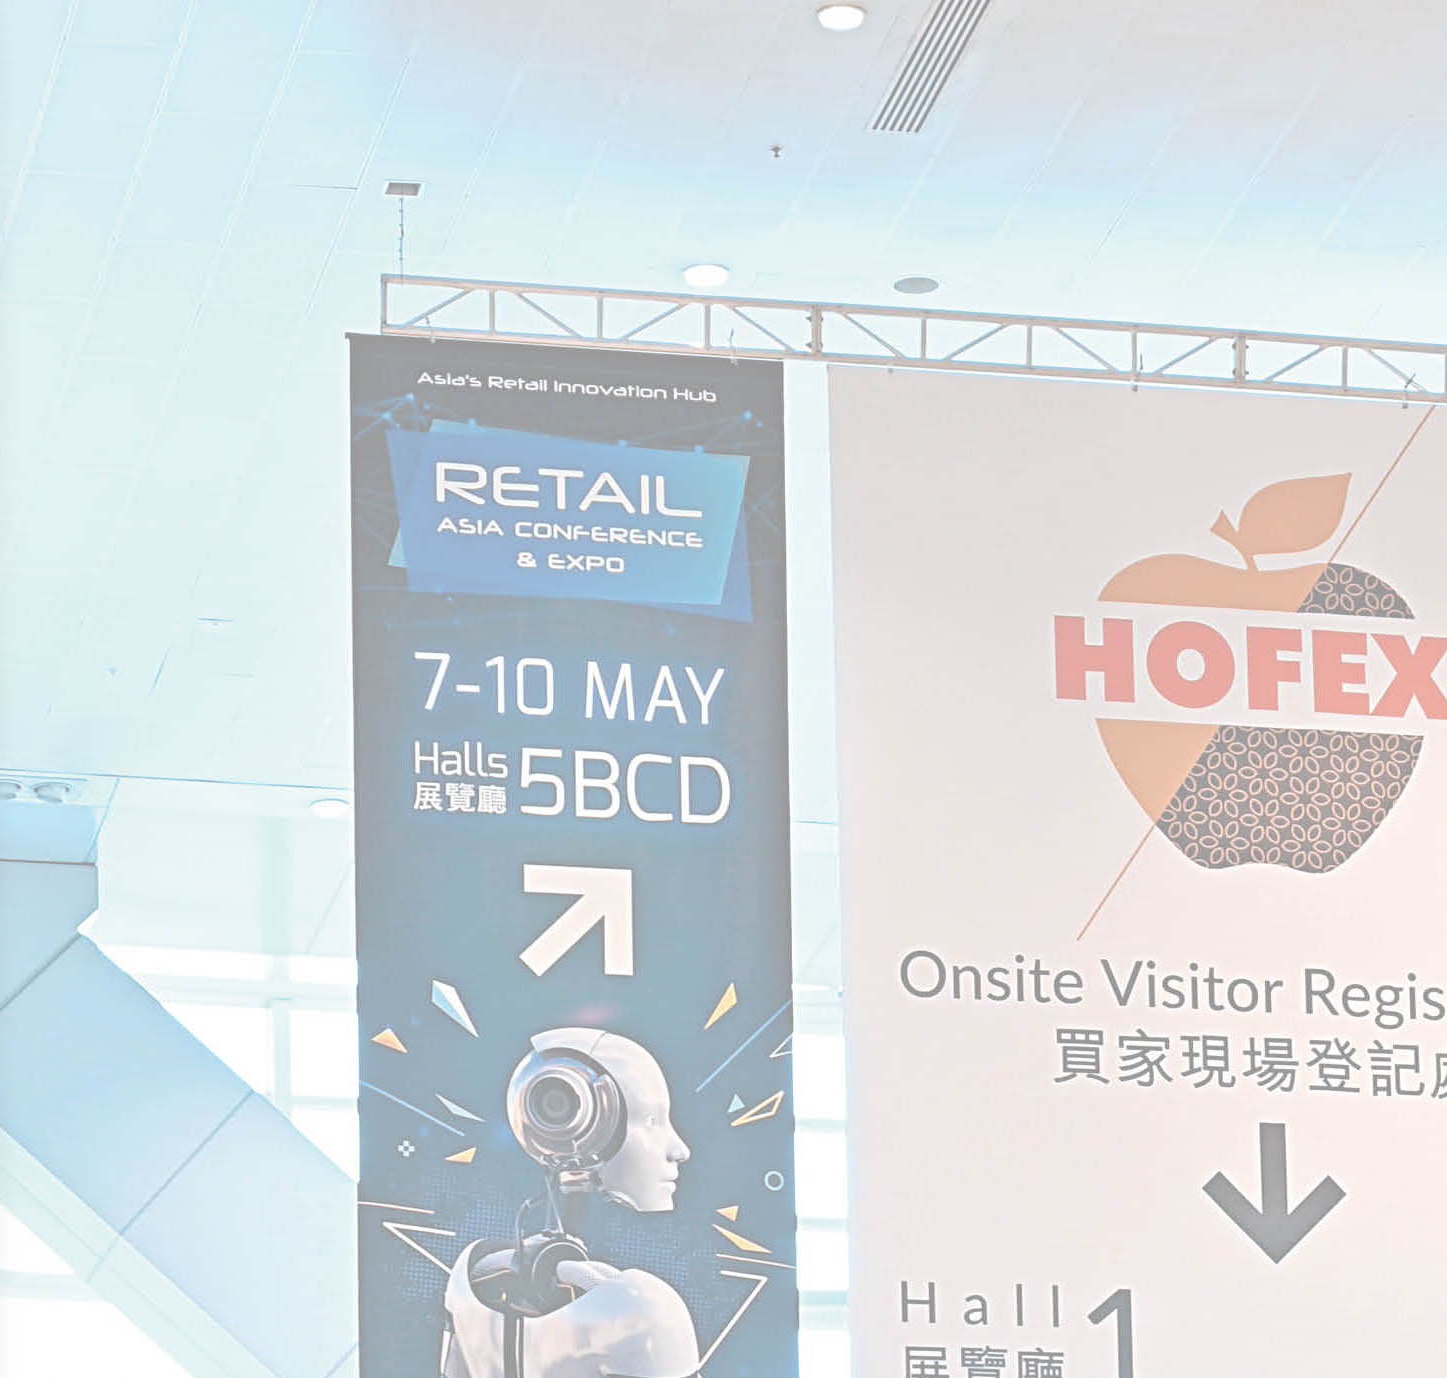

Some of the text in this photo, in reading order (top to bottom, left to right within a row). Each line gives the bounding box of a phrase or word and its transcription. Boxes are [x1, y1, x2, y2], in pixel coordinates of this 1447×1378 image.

[417, 372, 717, 402] Asia's Retail Innovation Hub
[436, 462, 703, 518] RETAIL
[437, 517, 703, 548] ASIA CONFERENCE
[517, 552, 625, 573] & EXPO
[414, 652, 725, 725] 7-10 MAY
[1054, 615, 1447, 721] HOFEX
[413, 781, 508, 815] 展覽廳
[414, 741, 731, 824] Halls 5BCD
[900, 950, 1084, 1005] Onsite
[1100, 958, 1284, 1014] Visitor
[900, 1280, 1061, 1328] Hall
